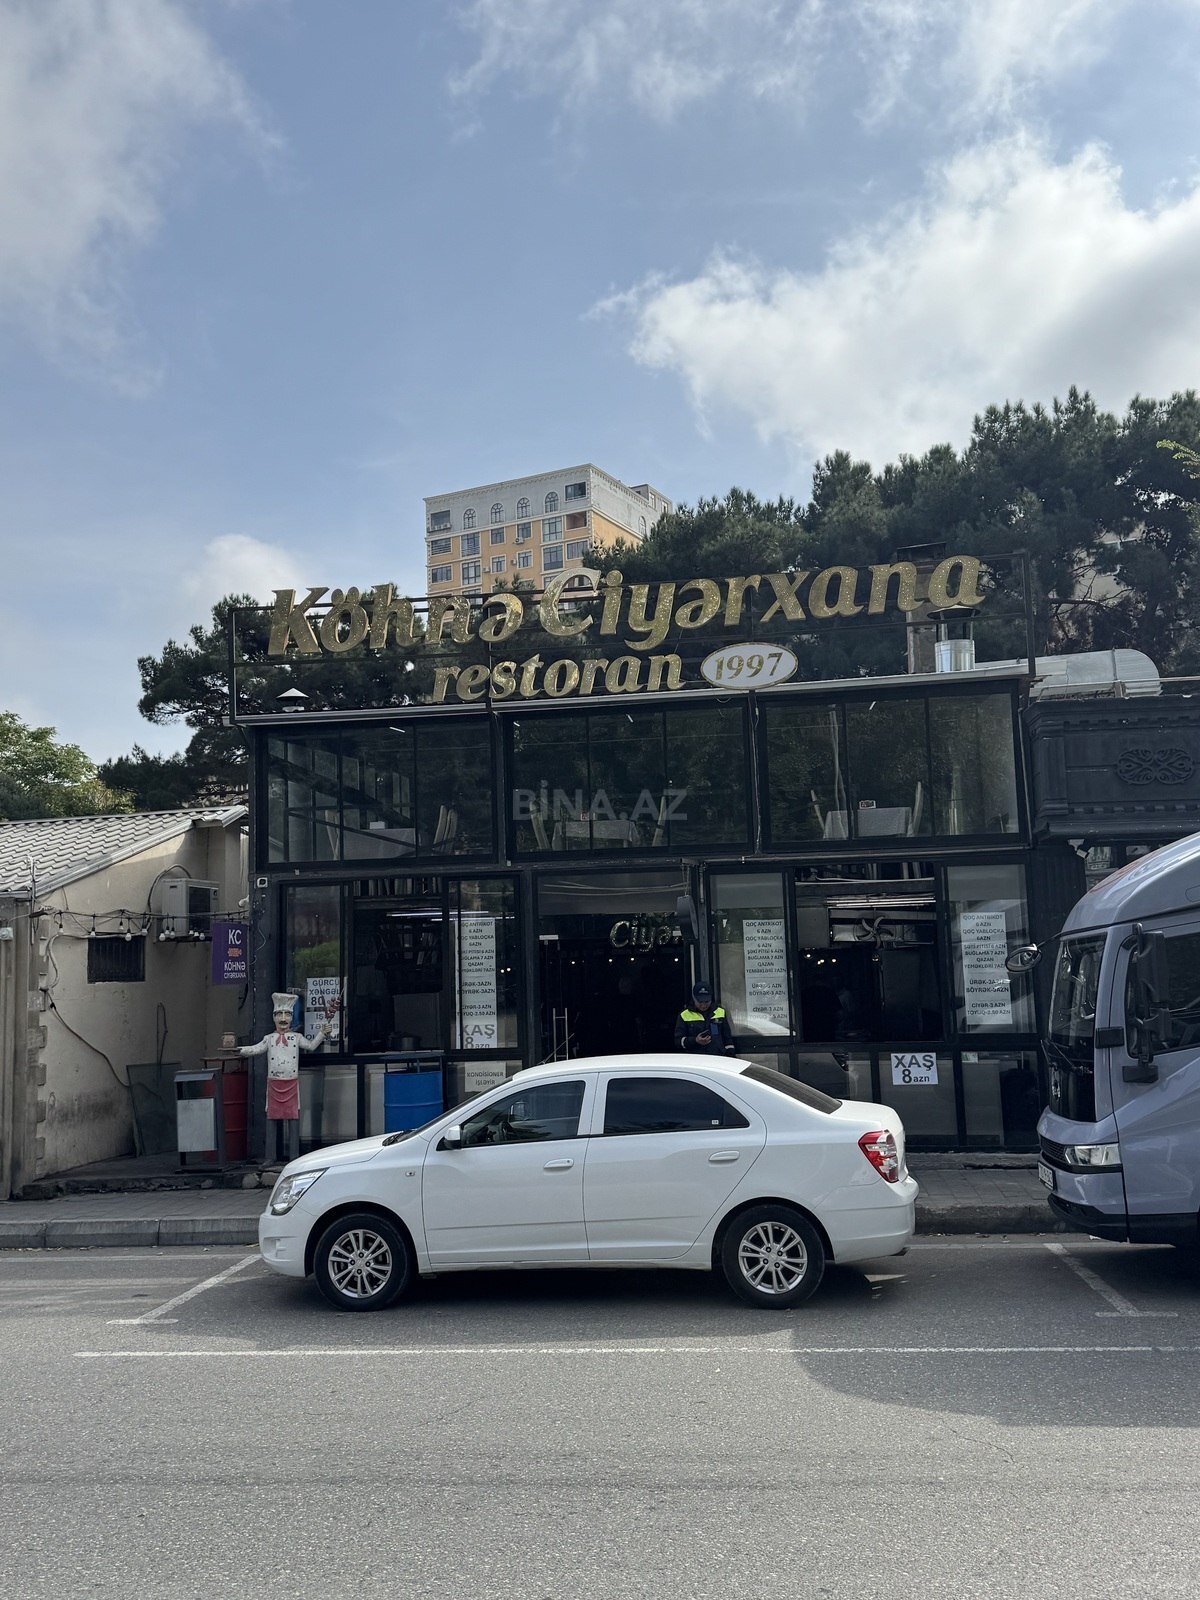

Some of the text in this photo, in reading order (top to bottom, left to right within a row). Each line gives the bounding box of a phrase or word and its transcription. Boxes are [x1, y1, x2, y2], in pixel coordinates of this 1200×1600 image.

[267, 555, 986, 656] Köhnə Ciyərxana
[714, 652, 784, 681] 1997
[432, 652, 687, 702] restoran
[228, 929, 242, 945] KC
[223, 959, 246, 971] KÖHNƏ
[465, 1036, 474, 1049] 8
[894, 1055, 935, 1071] XAŞ
[902, 1069, 913, 1084] 8
